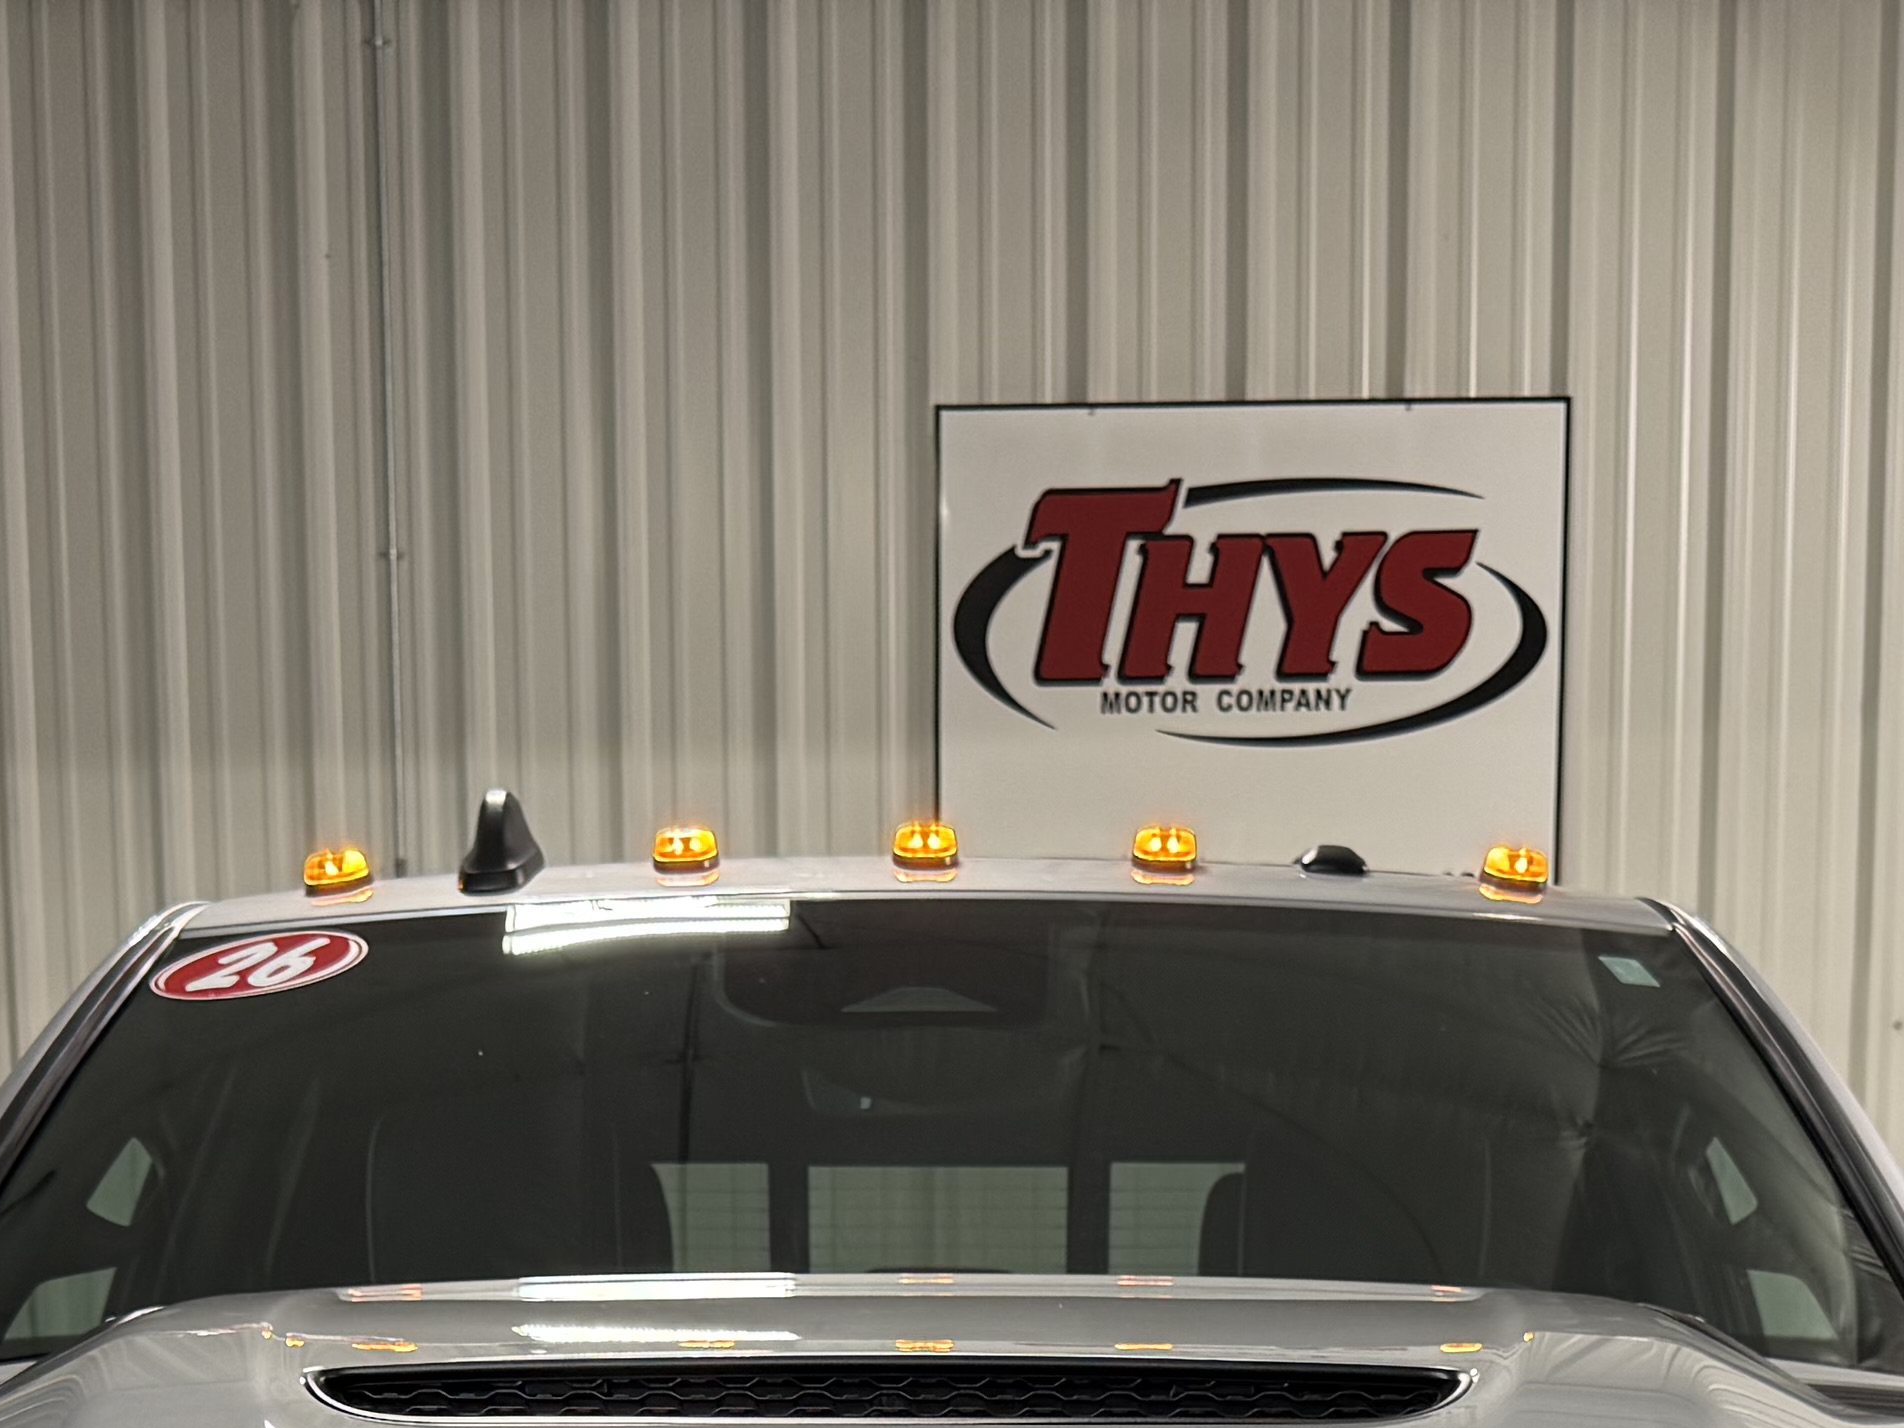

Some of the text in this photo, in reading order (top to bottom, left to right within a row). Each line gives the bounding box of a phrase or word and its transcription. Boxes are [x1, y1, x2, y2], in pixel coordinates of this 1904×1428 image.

[1022, 478, 1480, 687] THYS
[1100, 688, 1353, 714] MOTOR COMPANY
[184, 936, 334, 993] 26
